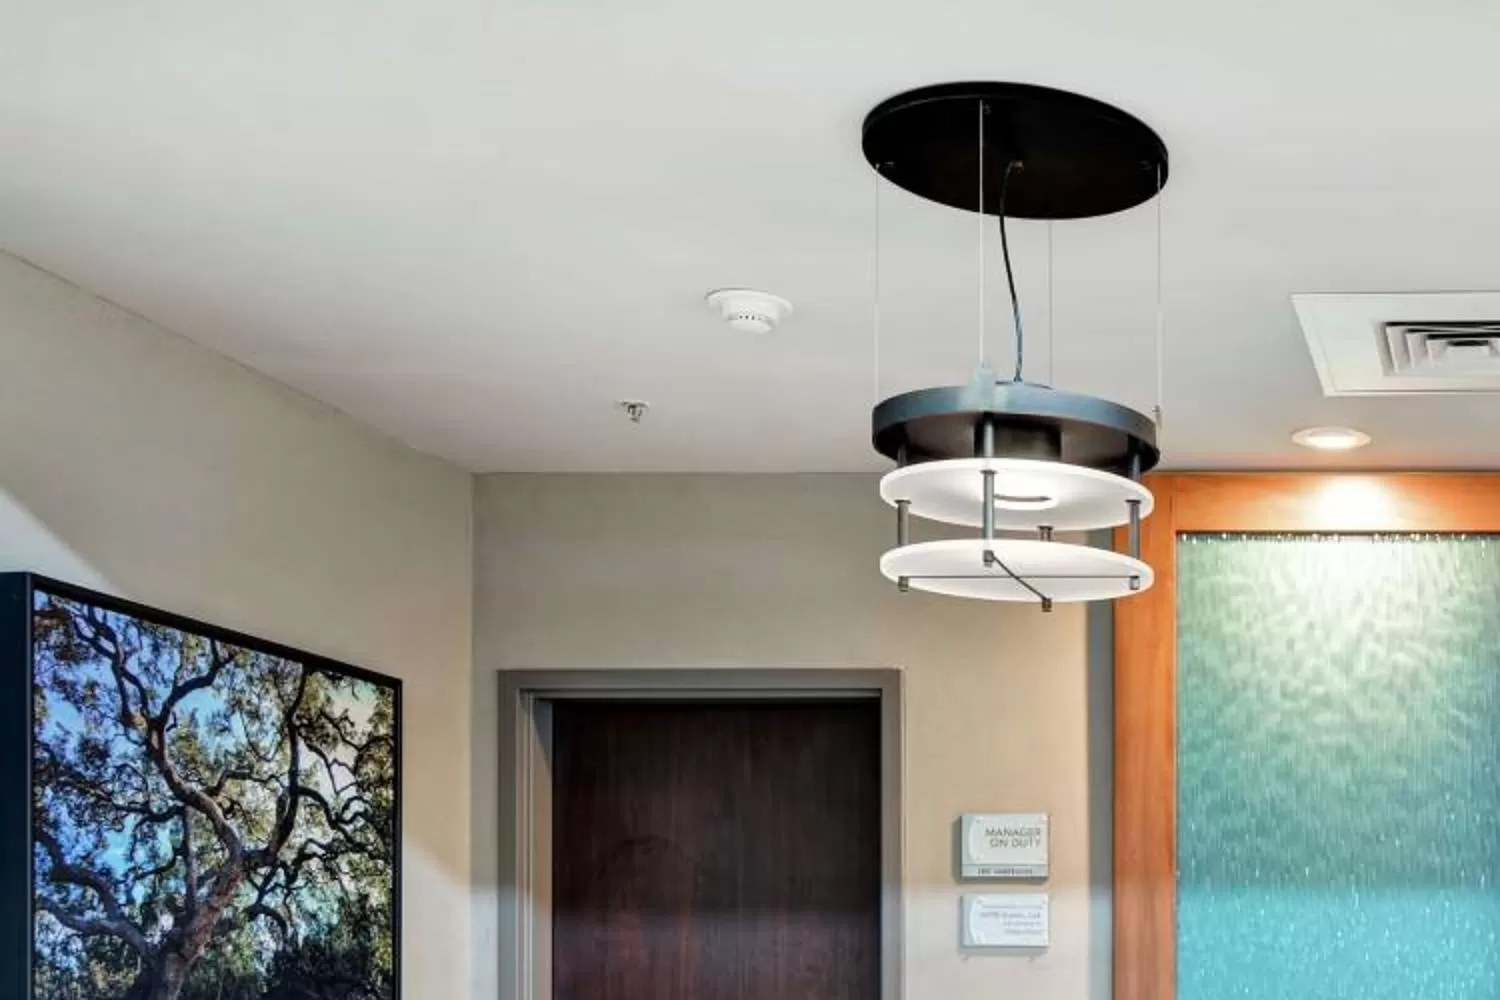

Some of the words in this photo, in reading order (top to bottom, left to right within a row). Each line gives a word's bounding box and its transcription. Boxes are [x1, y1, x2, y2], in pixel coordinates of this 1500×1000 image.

[985, 828, 1041, 837] MANAGER
[990, 838, 1008, 848] ON
[1012, 838, 1041, 848] DUTY
